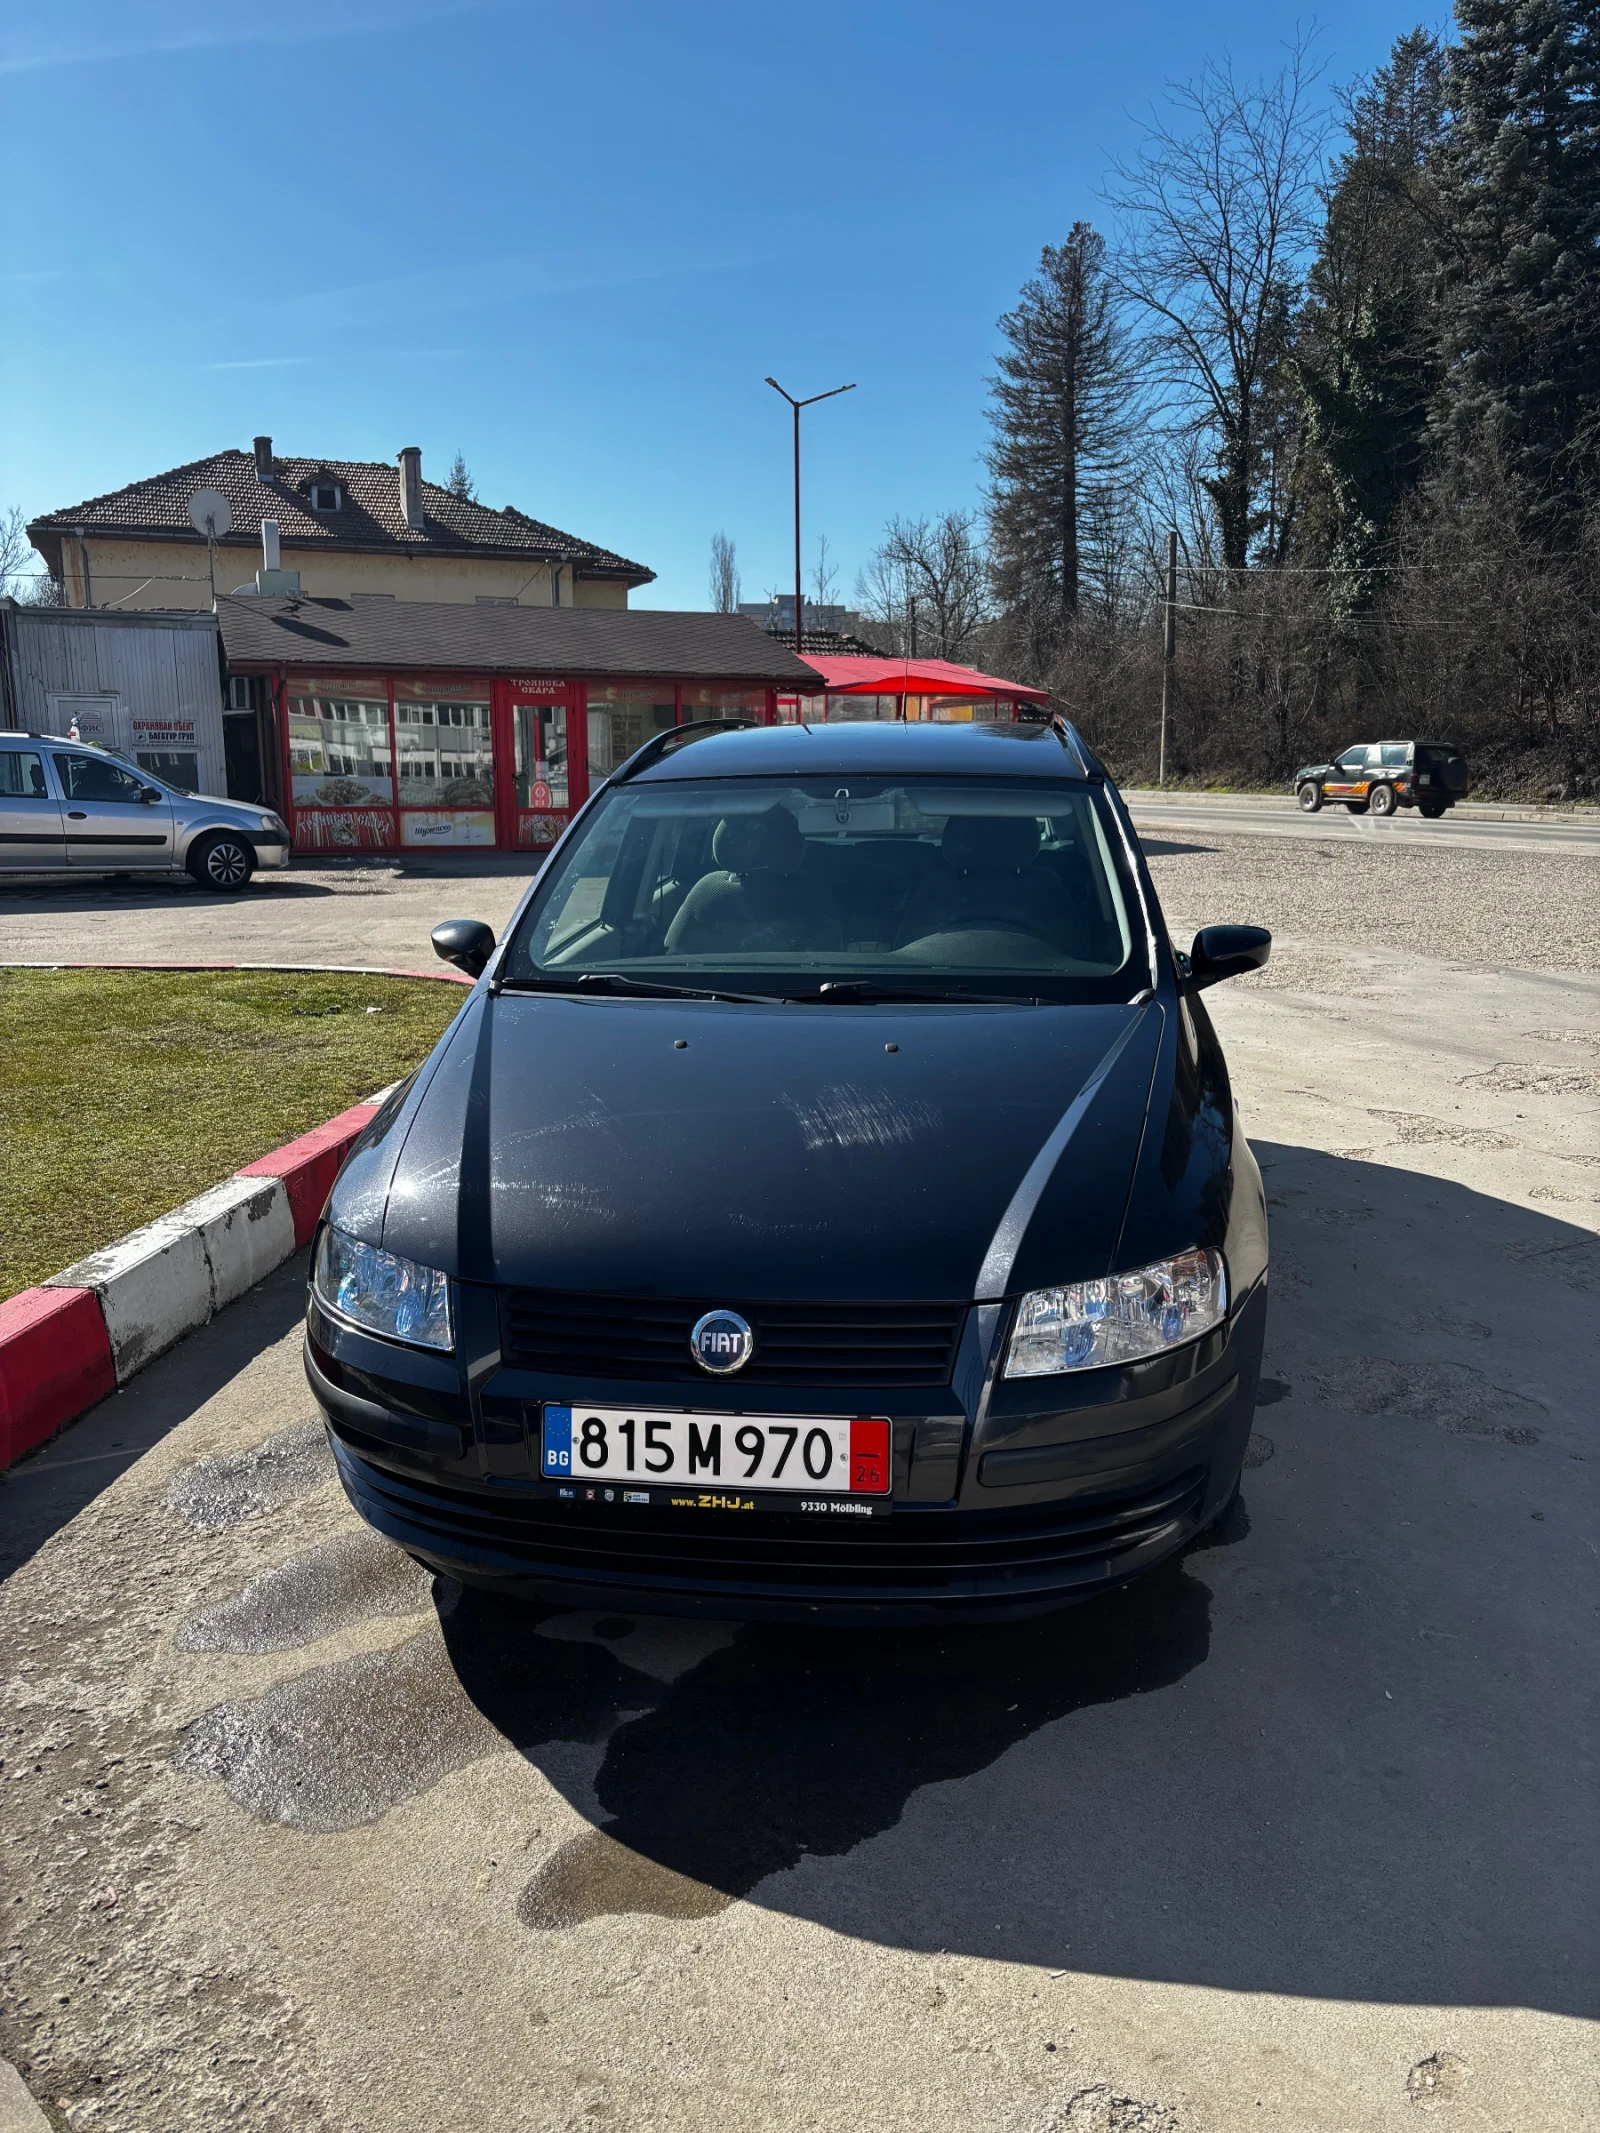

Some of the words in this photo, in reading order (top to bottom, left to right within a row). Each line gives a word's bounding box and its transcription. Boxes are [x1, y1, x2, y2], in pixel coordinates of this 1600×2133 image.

[510, 679, 566, 688] ТРОЯНСКА
[521, 687, 556, 695] СКАРА
[132, 720, 172, 731] ОХРАНЯВАН
[148, 732, 177, 740] БАГАТУР
[414, 824, 452, 837] Шуменско
[700, 1331, 742, 1354] FIAT
[547, 1450, 569, 1467] BG
[855, 1465, 881, 1483] 26
[670, 1494, 755, 1510] www.ZHJ.at
[801, 1501, 828, 1512] 9330
[830, 1502, 873, 1515] Mölbling
